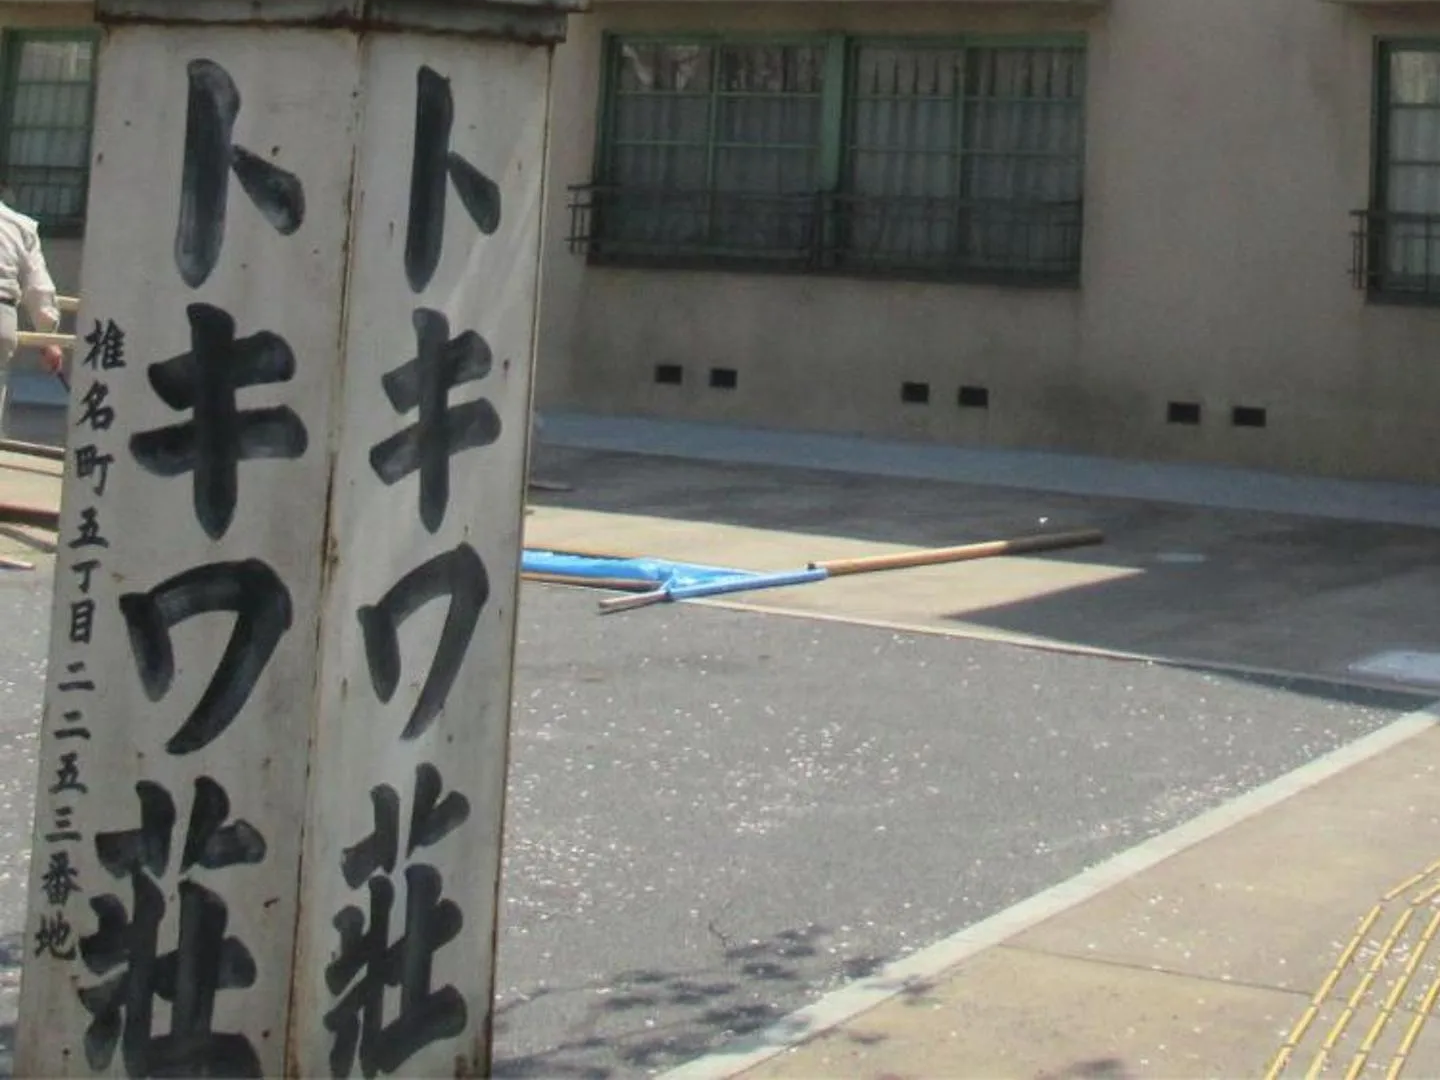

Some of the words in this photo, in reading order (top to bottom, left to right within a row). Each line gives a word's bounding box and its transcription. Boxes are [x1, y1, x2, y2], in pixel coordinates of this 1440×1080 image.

[34, 318, 127, 960] 椎名町五丁目二二五三番地
